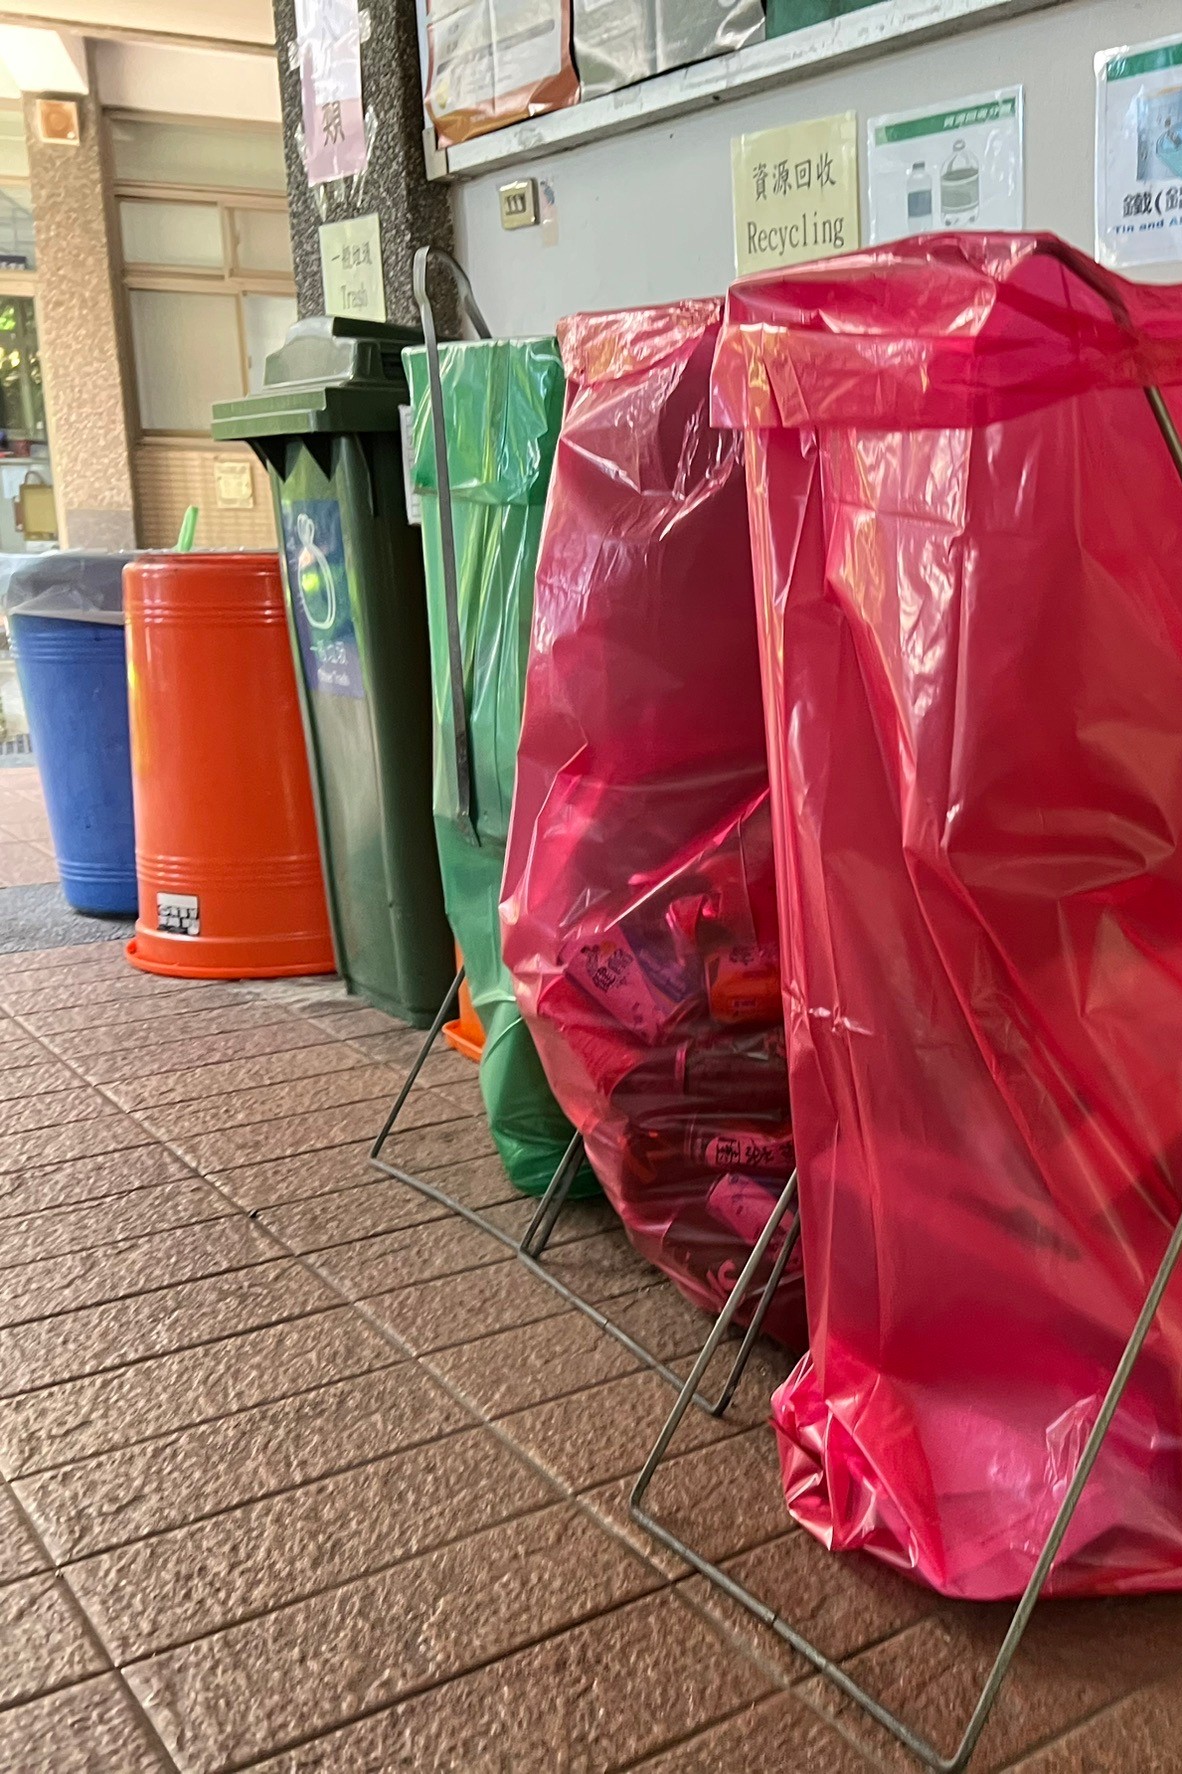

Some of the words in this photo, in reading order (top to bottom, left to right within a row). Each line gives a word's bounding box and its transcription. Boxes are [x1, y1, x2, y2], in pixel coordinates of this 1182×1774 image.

[752, 152, 836, 202] 資源回收
[747, 211, 845, 256] Recycling
[1113, 223, 1135, 235] Tin
[1139, 218, 1164, 232] and
